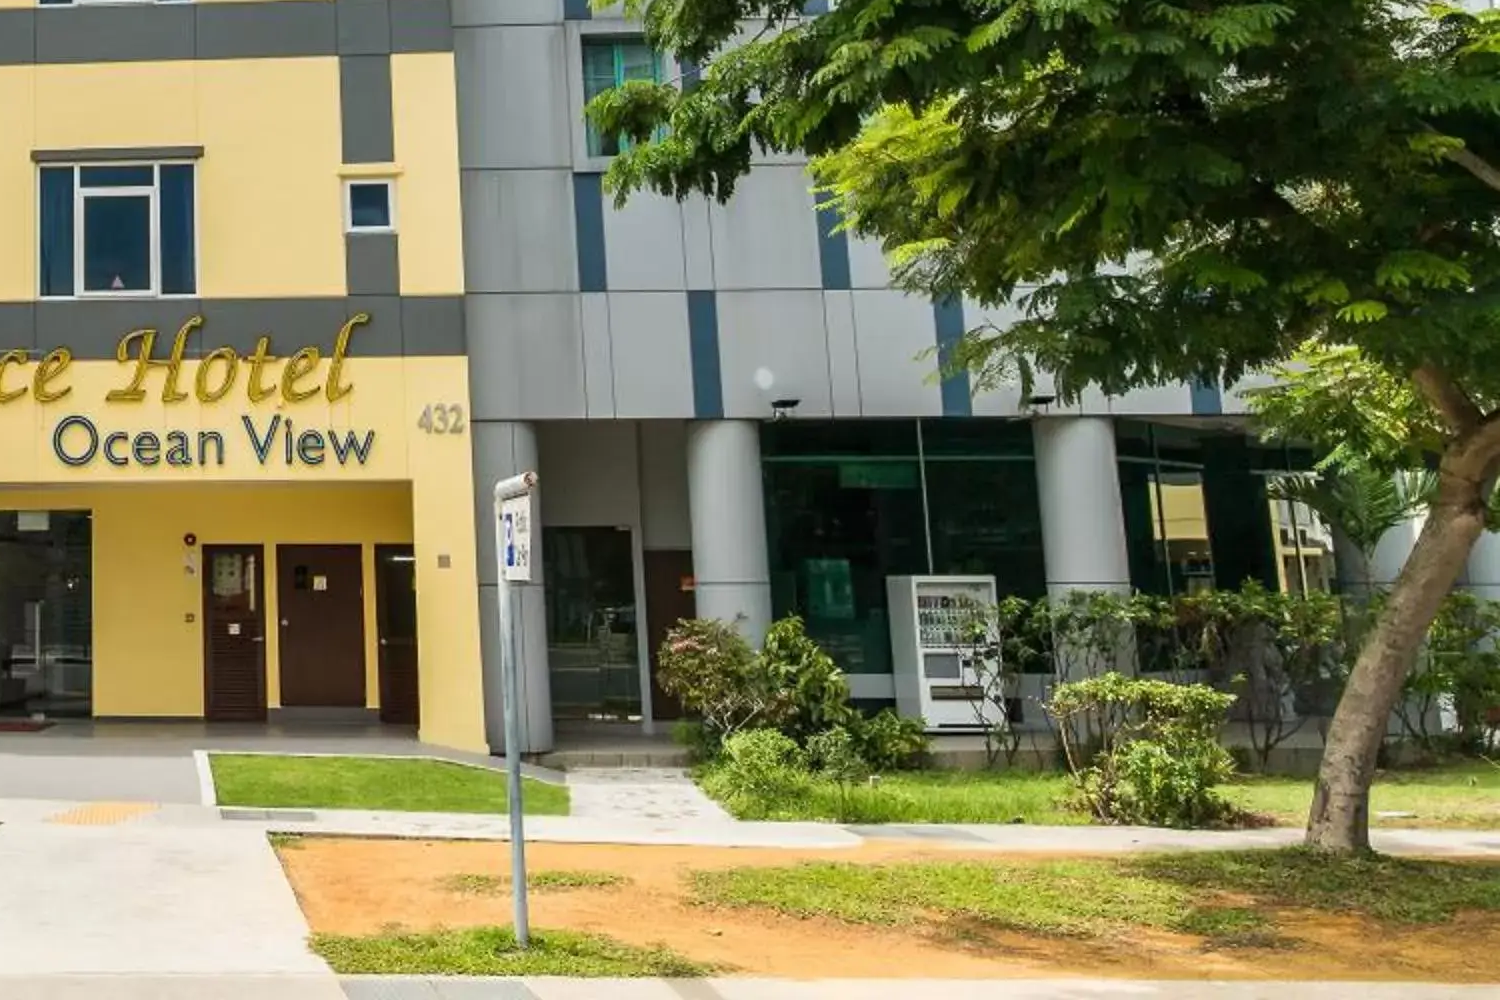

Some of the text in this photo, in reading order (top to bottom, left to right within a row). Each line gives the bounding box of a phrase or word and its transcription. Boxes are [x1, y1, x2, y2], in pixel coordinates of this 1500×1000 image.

[105, 313, 371, 403] Hotel
[52, 413, 377, 468] Ocean View
[417, 402, 465, 434] 432
